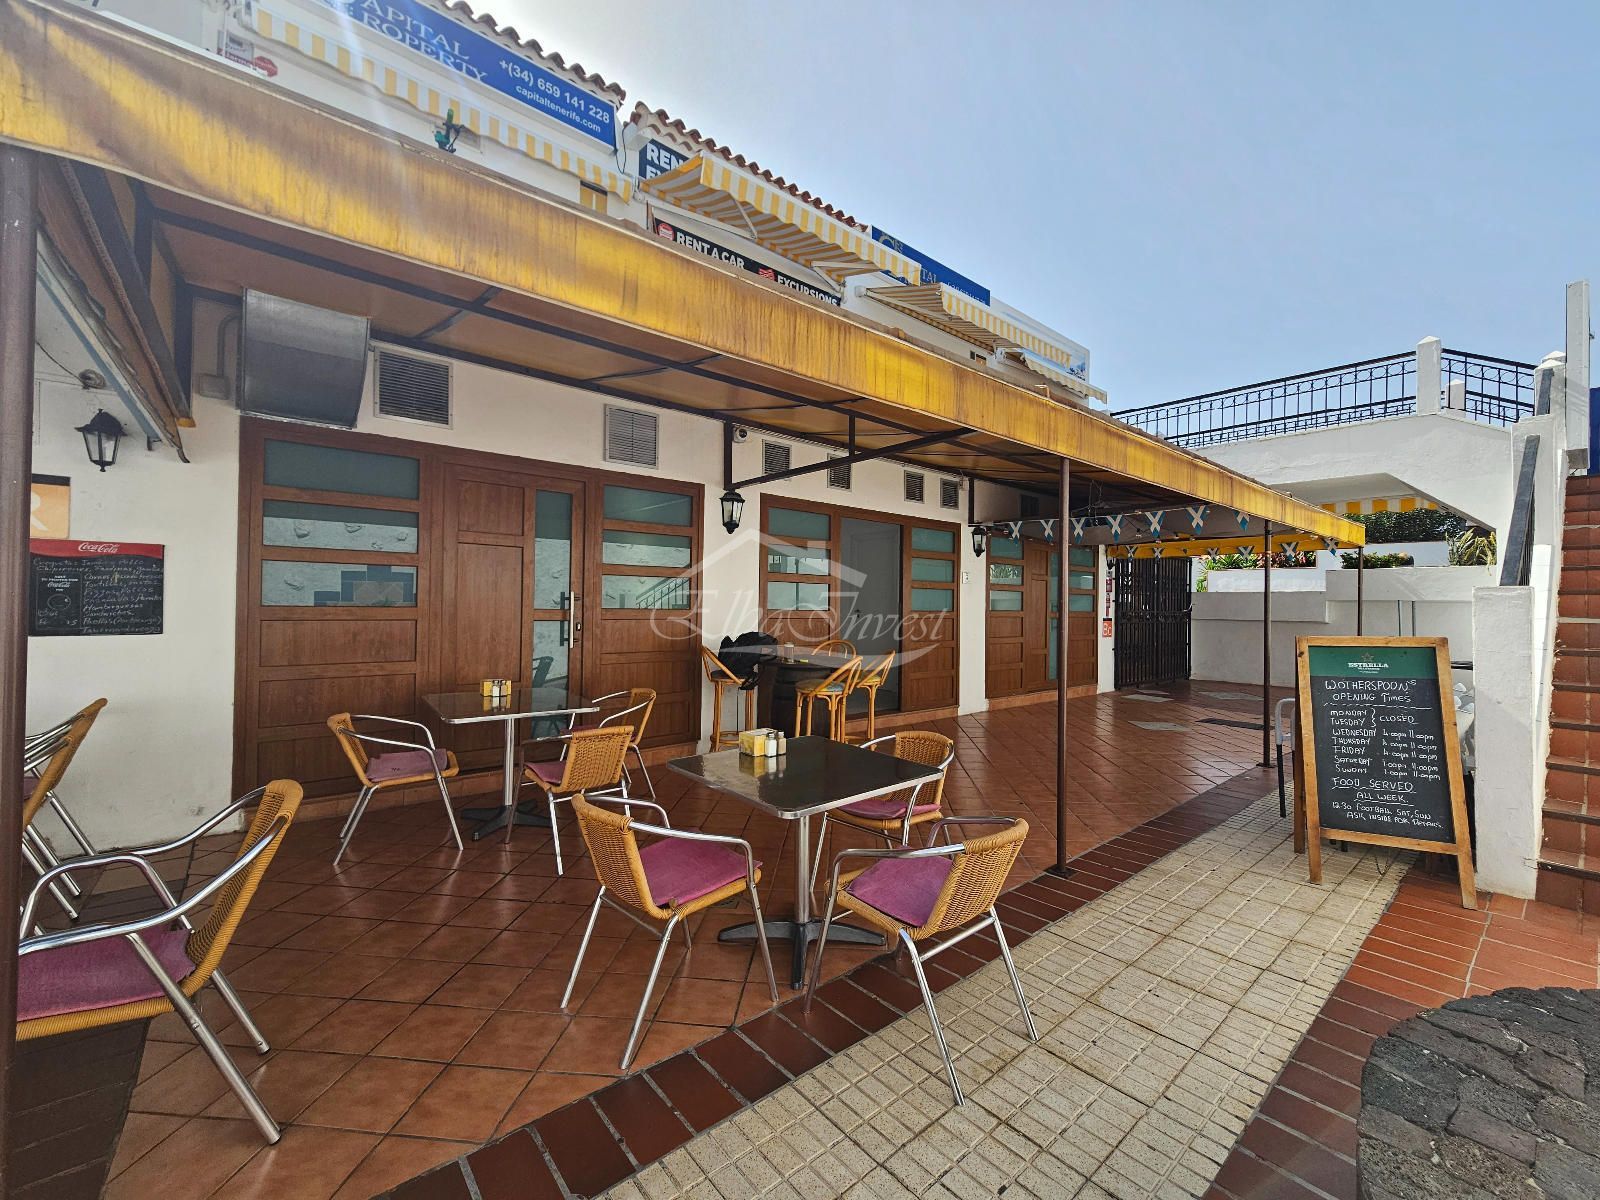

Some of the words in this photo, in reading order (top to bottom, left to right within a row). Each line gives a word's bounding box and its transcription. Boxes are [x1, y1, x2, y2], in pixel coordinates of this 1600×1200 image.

[499, 60, 534, 87] +(34)
[537, 78, 561, 98] 659
[564, 92, 585, 111] 141
[588, 104, 610, 124] 228
[515, 85, 601, 133] capitaltenerife.com
[647, 143, 685, 169] REN
[676, 231, 711, 258] RENT
[711, 247, 720, 260] A
[721, 251, 745, 270] CAR
[78, 542, 120, 554] Coca-Cola
[1332, 692, 1377, 701] OPENING
[1330, 717, 1366, 727] TUESDAY
[1332, 728, 1377, 737] WEDNESDAY
[1332, 745, 1366, 755] FRIDAY
[1331, 776, 1360, 787] FOOD
[1369, 778, 1414, 792] SERVED
[1356, 791, 1374, 800] ALL
[1346, 811, 1366, 820] ASK
[1369, 813, 1392, 823] INSIDE
